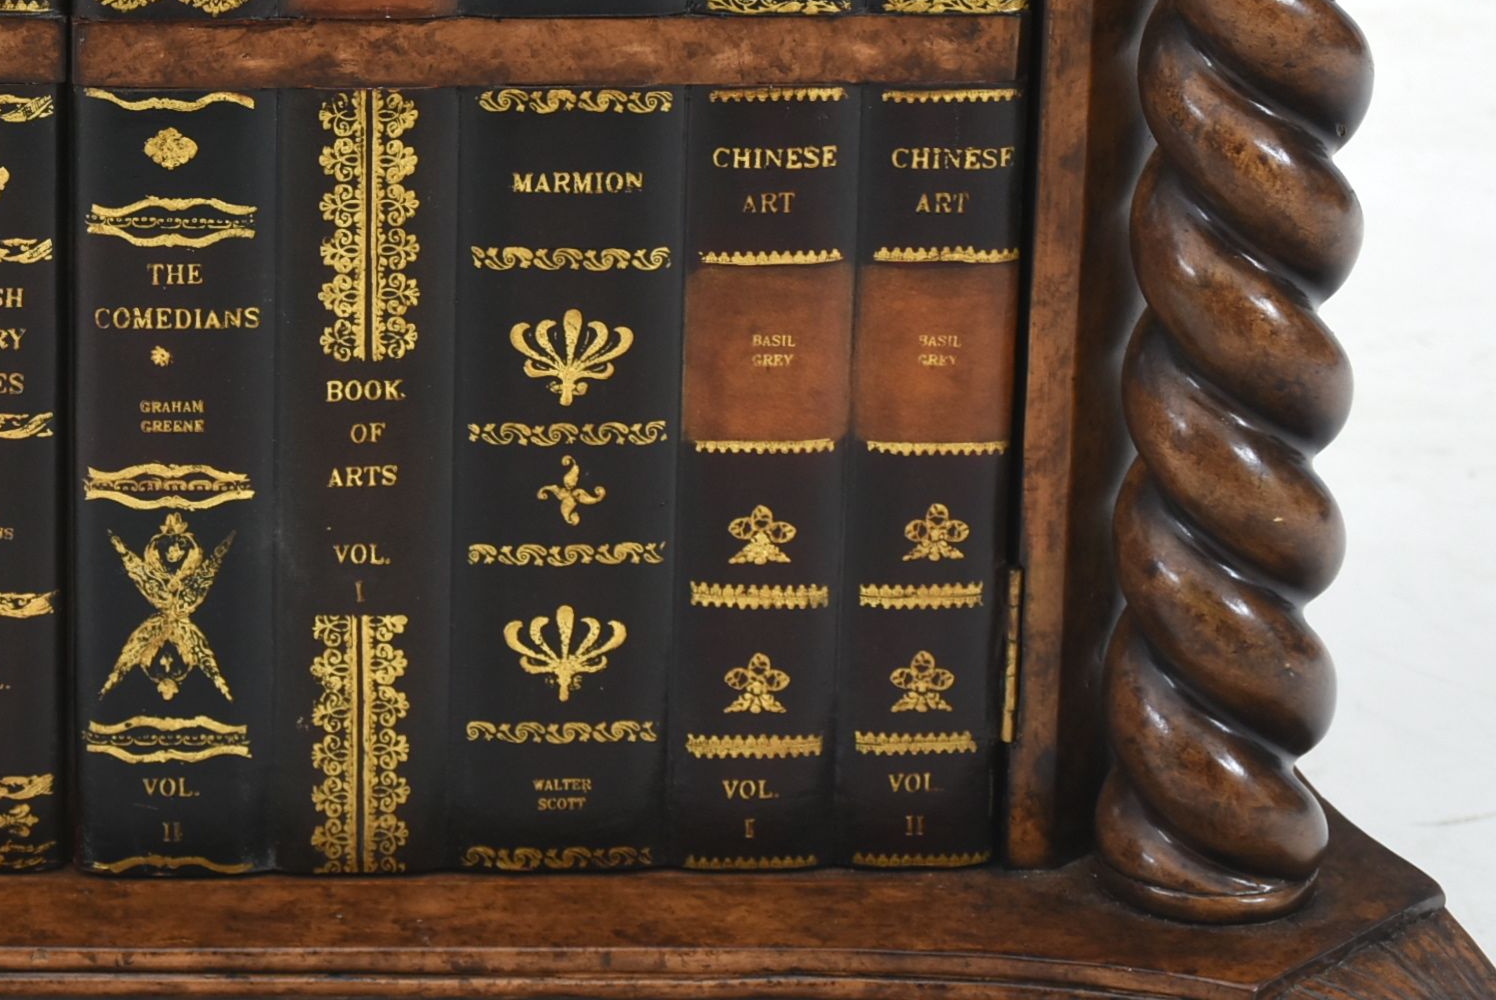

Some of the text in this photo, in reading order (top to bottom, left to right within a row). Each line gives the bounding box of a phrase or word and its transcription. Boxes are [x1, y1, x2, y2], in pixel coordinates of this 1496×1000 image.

[713, 146, 838, 169] CHINESE
[512, 172, 644, 195] MARMION
[743, 193, 795, 214] ART
[915, 193, 969, 214] ART
[146, 264, 203, 286] THE
[94, 307, 260, 331] COMEDIANS
[752, 335, 796, 347] BASIL
[752, 354, 794, 367] GREY
[140, 400, 204, 414] GRAHAM
[140, 419, 204, 434] GREENE
[350, 422, 386, 444] OF
[327, 465, 398, 488] ARTS
[333, 543, 392, 566] VOL.
[354, 580, 364, 602] I
[143, 778, 200, 799] VOL.
[532, 778, 592, 792] WALTER
[722, 780, 779, 800] VOL.
[537, 796, 586, 811] SCOTT
[162, 822, 182, 843] II
[744, 819, 755, 838] I
[906, 816, 924, 836] II
